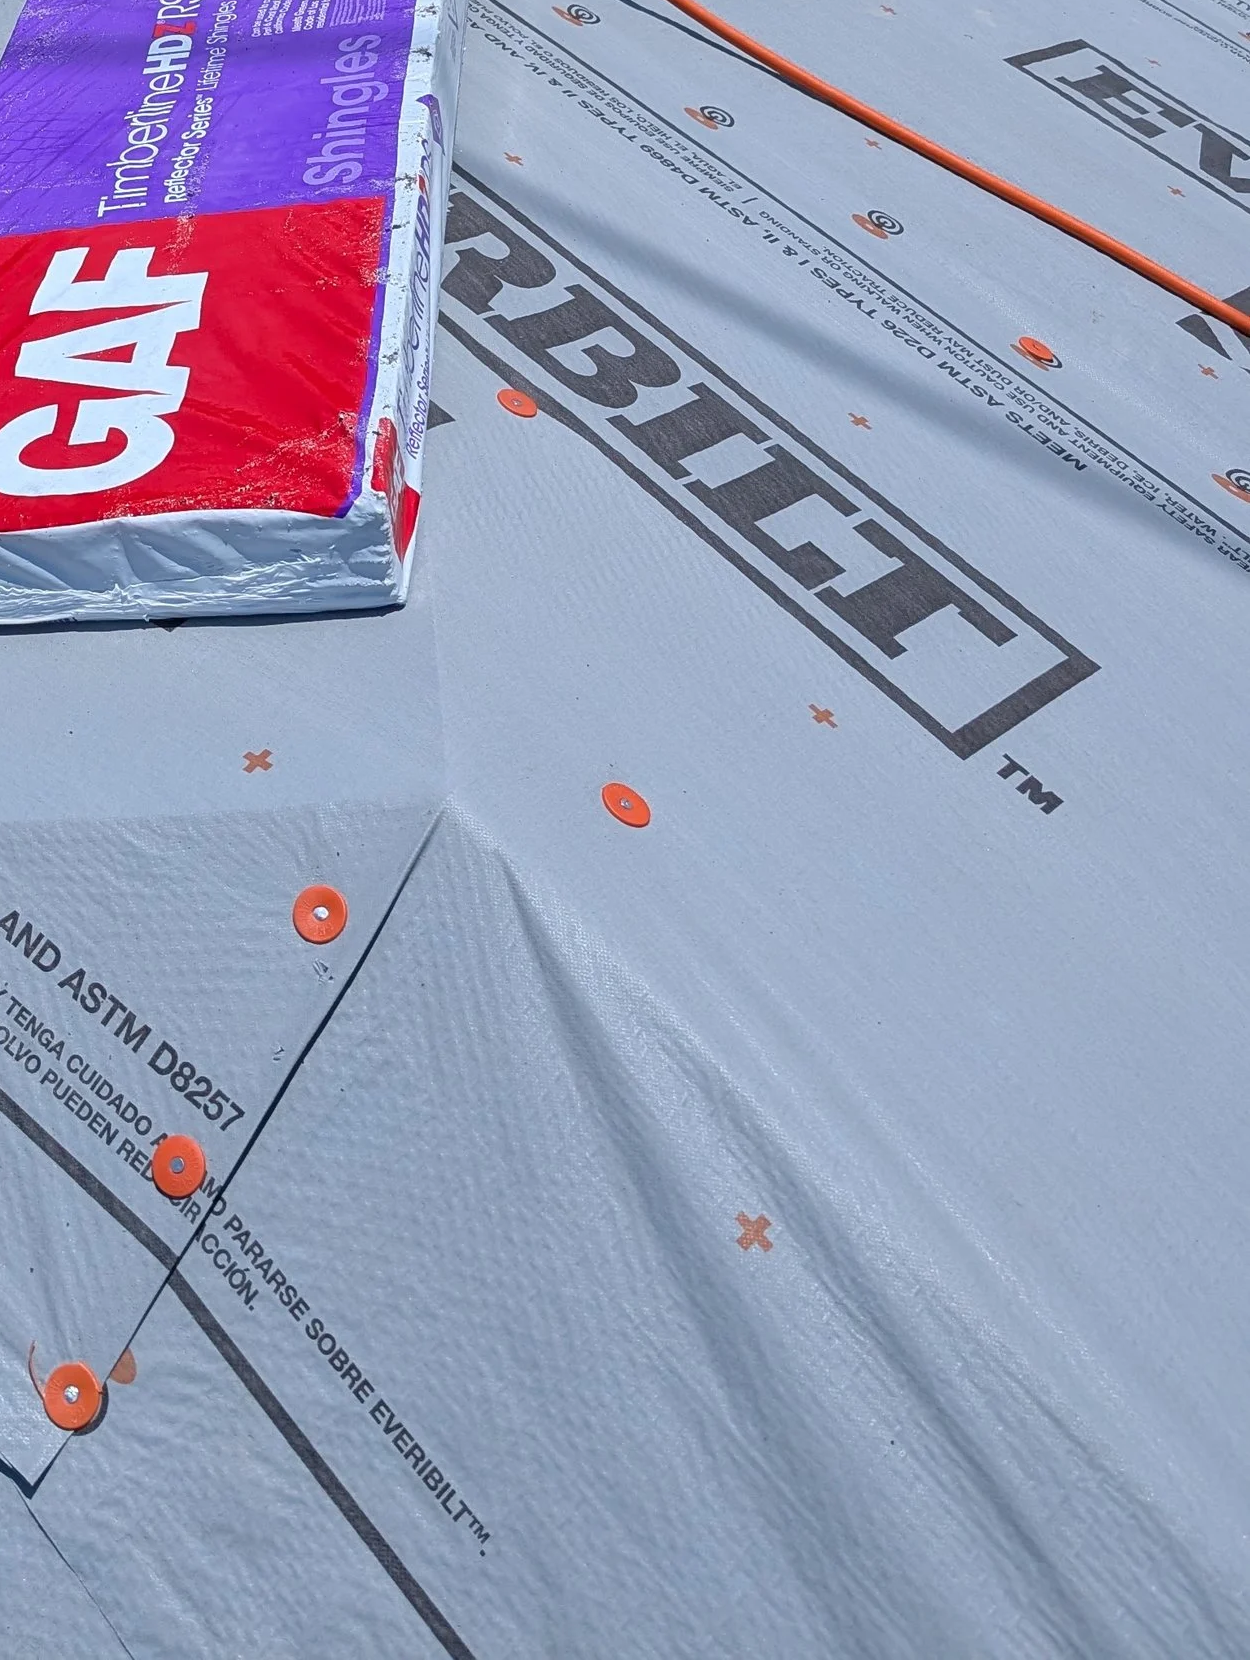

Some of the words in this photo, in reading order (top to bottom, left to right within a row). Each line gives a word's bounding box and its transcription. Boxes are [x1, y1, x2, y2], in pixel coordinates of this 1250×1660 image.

[484, 33, 531, 68] AND
[524, 62, 547, 76] IV,
[164, 141, 196, 203] Reflector
[207, 0, 238, 46] Shingles
[547, 77, 563, 87] &
[560, 83, 579, 101] II
[302, 33, 389, 187] Shingles
[577, 99, 638, 143] TYPES
[639, 144, 699, 185] D4869
[698, 187, 760, 226] ASTM
[758, 210, 822, 256] STANDING
[762, 229, 781, 244] II,
[782, 244, 799, 257] &
[796, 254, 810, 270] I
[820, 255, 842, 271] OR
[810, 267, 878, 320] TYPES
[842, 271, 901, 316] WALKING
[887, 294, 944, 335] REDUCE
[901, 315, 943, 346] WHEN
[880, 319, 937, 360] D226
[943, 337, 975, 358] MAY
[936, 360, 1004, 407] ASTM
[943, 345, 1005, 391] CAUTION
[973, 359, 1014, 386] DUST
[1005, 390, 1035, 414] USE
[1013, 386, 1071, 426] AND/OR
[405, 393, 430, 459] Reflector
[1005, 410, 1089, 472] MEETS
[1036, 414, 1070, 436] AND
[1068, 439, 1157, 502] EQUIPMENT
[1074, 430, 1130, 471] DEBRIS,
[1132, 472, 1161, 494] ICE,
[1155, 503, 1217, 546] SAFETY
[1164, 492, 1217, 537] WATER,
[995, 753, 1065, 815] TM
[56, 967, 153, 1054] ASTM
[146, 1040, 246, 1132] D8257
[39, 1067, 120, 1146] PUEDEN
[5, 995, 66, 1061] TENGA
[66, 1054, 153, 1136] CUIDADO
[222, 1213, 311, 1322] PARARSE
[305, 1317, 376, 1405] SOBRE
